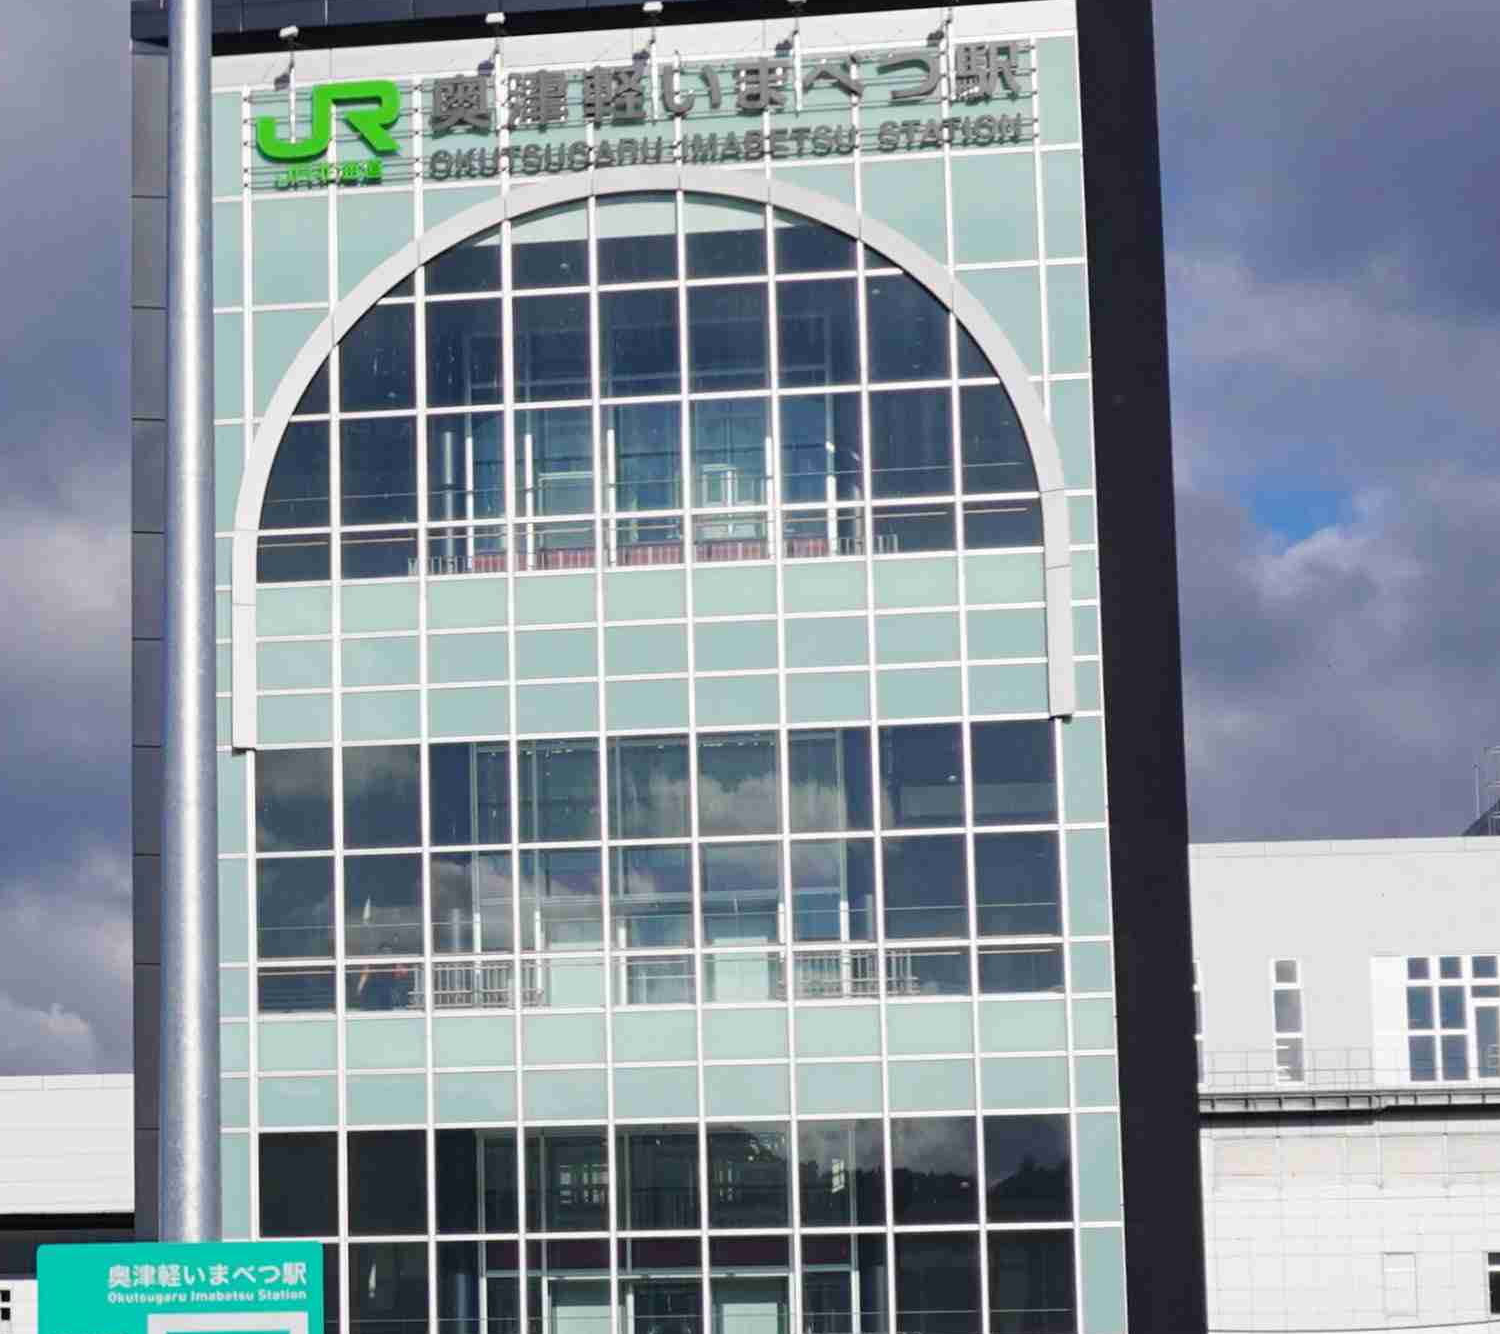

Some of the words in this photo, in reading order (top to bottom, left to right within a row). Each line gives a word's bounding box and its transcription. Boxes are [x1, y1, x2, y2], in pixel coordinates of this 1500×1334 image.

[430, 43, 1021, 136] 奥津軽いまべつ駅
[256, 79, 402, 163] JR
[877, 113, 1023, 153] STATION
[108, 1262, 307, 1288] 奥津軽いまべつ駅
[108, 1292, 187, 1305] Okutsugaru
[191, 1291, 253, 1302] Imabetsu
[258, 1290, 307, 1301] Station
